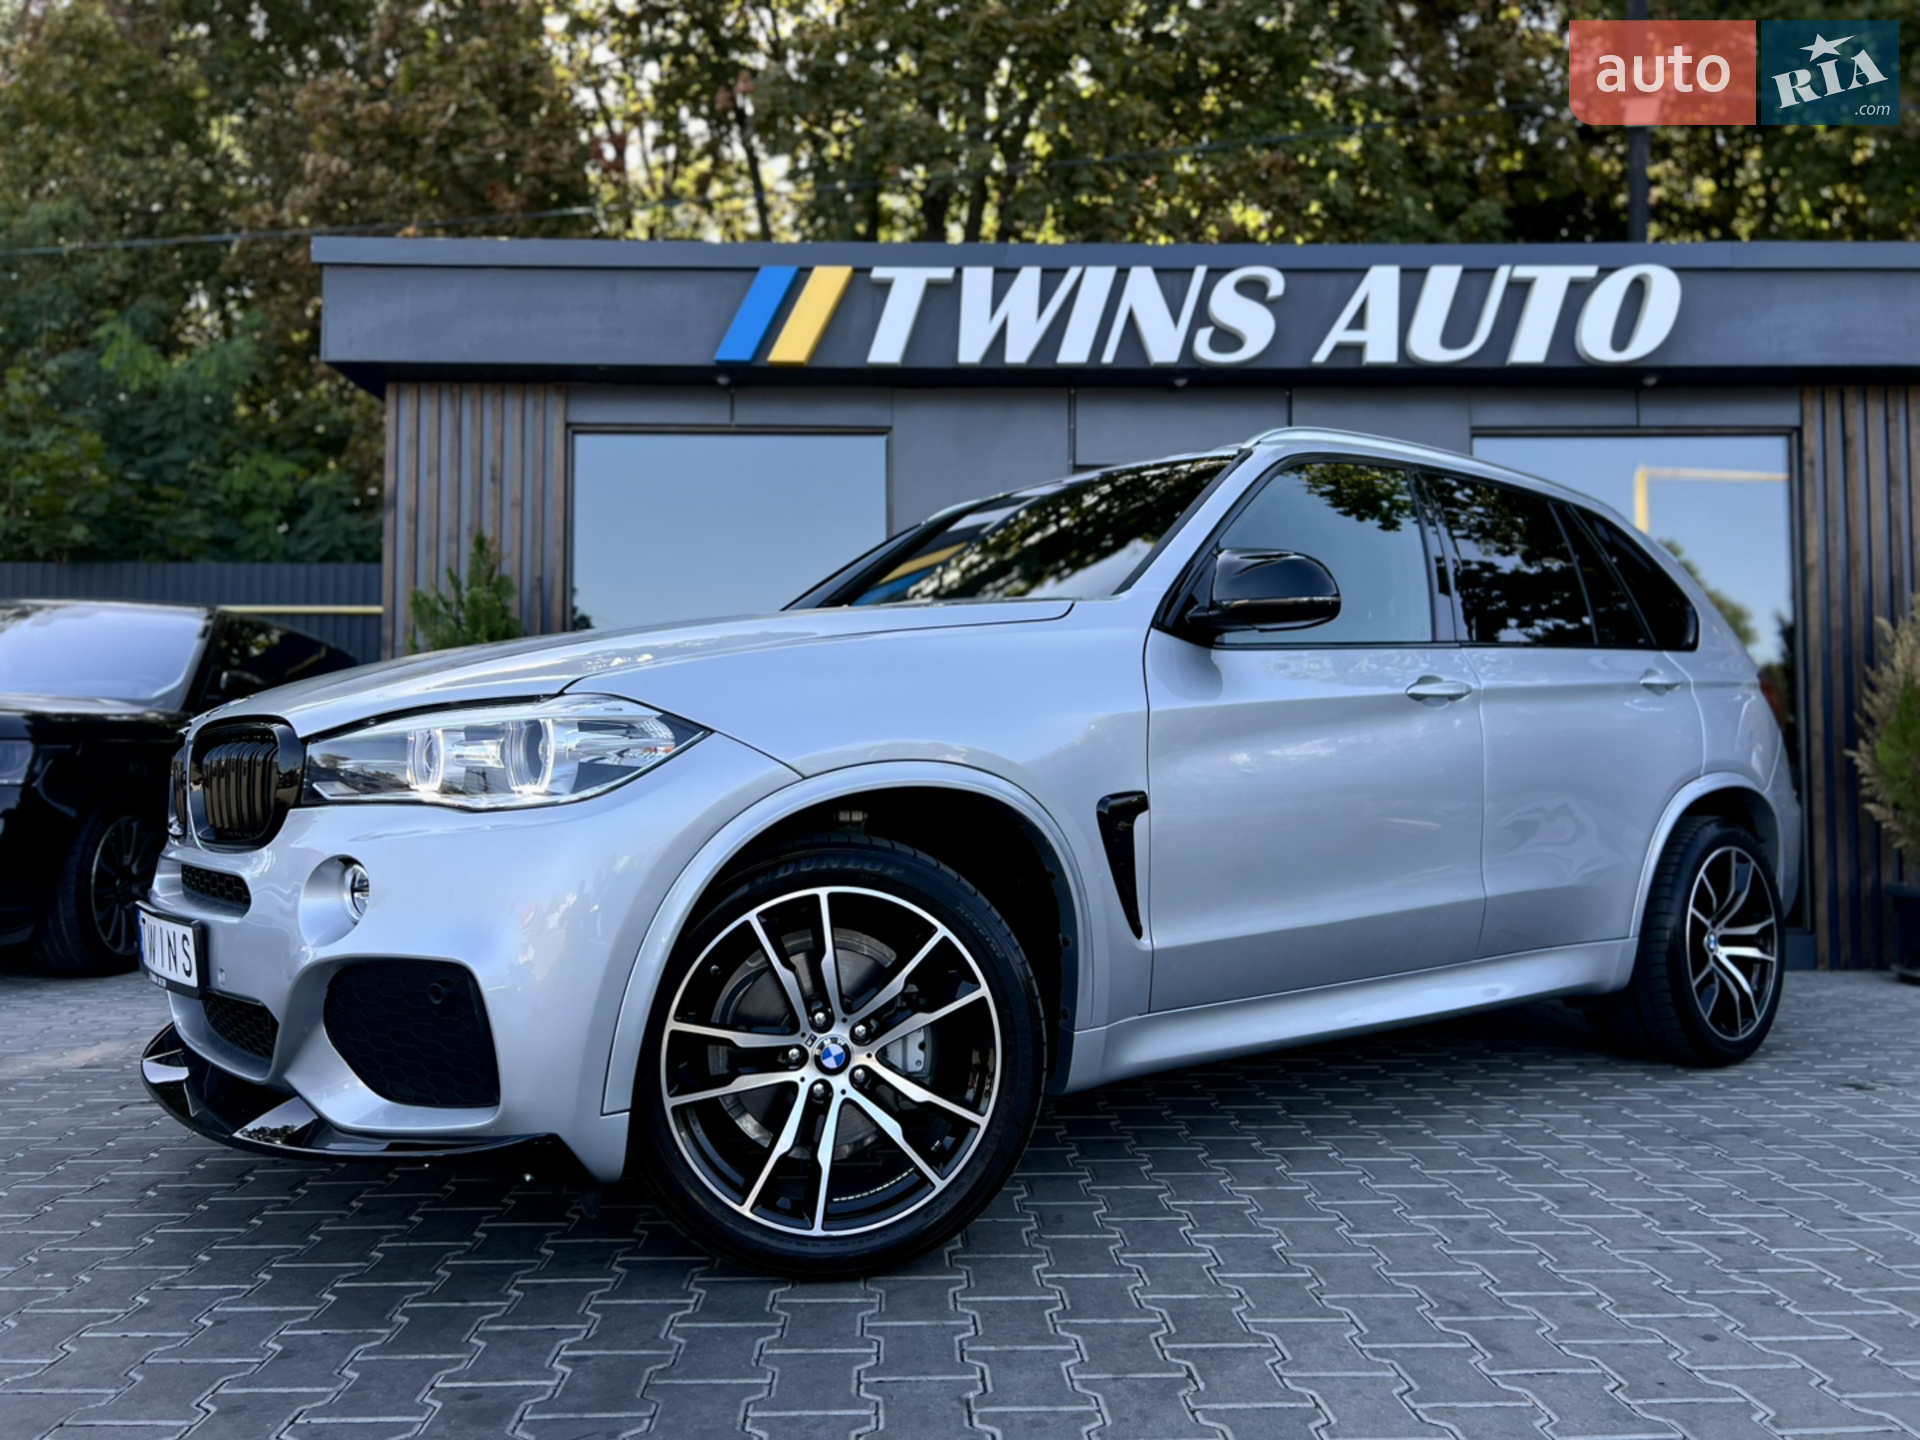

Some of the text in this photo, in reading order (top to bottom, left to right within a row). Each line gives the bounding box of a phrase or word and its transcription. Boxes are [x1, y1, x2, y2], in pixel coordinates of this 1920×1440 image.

[866, 262, 1682, 364] TWINS AUTO
[775, 855, 906, 879] DUNLOP
